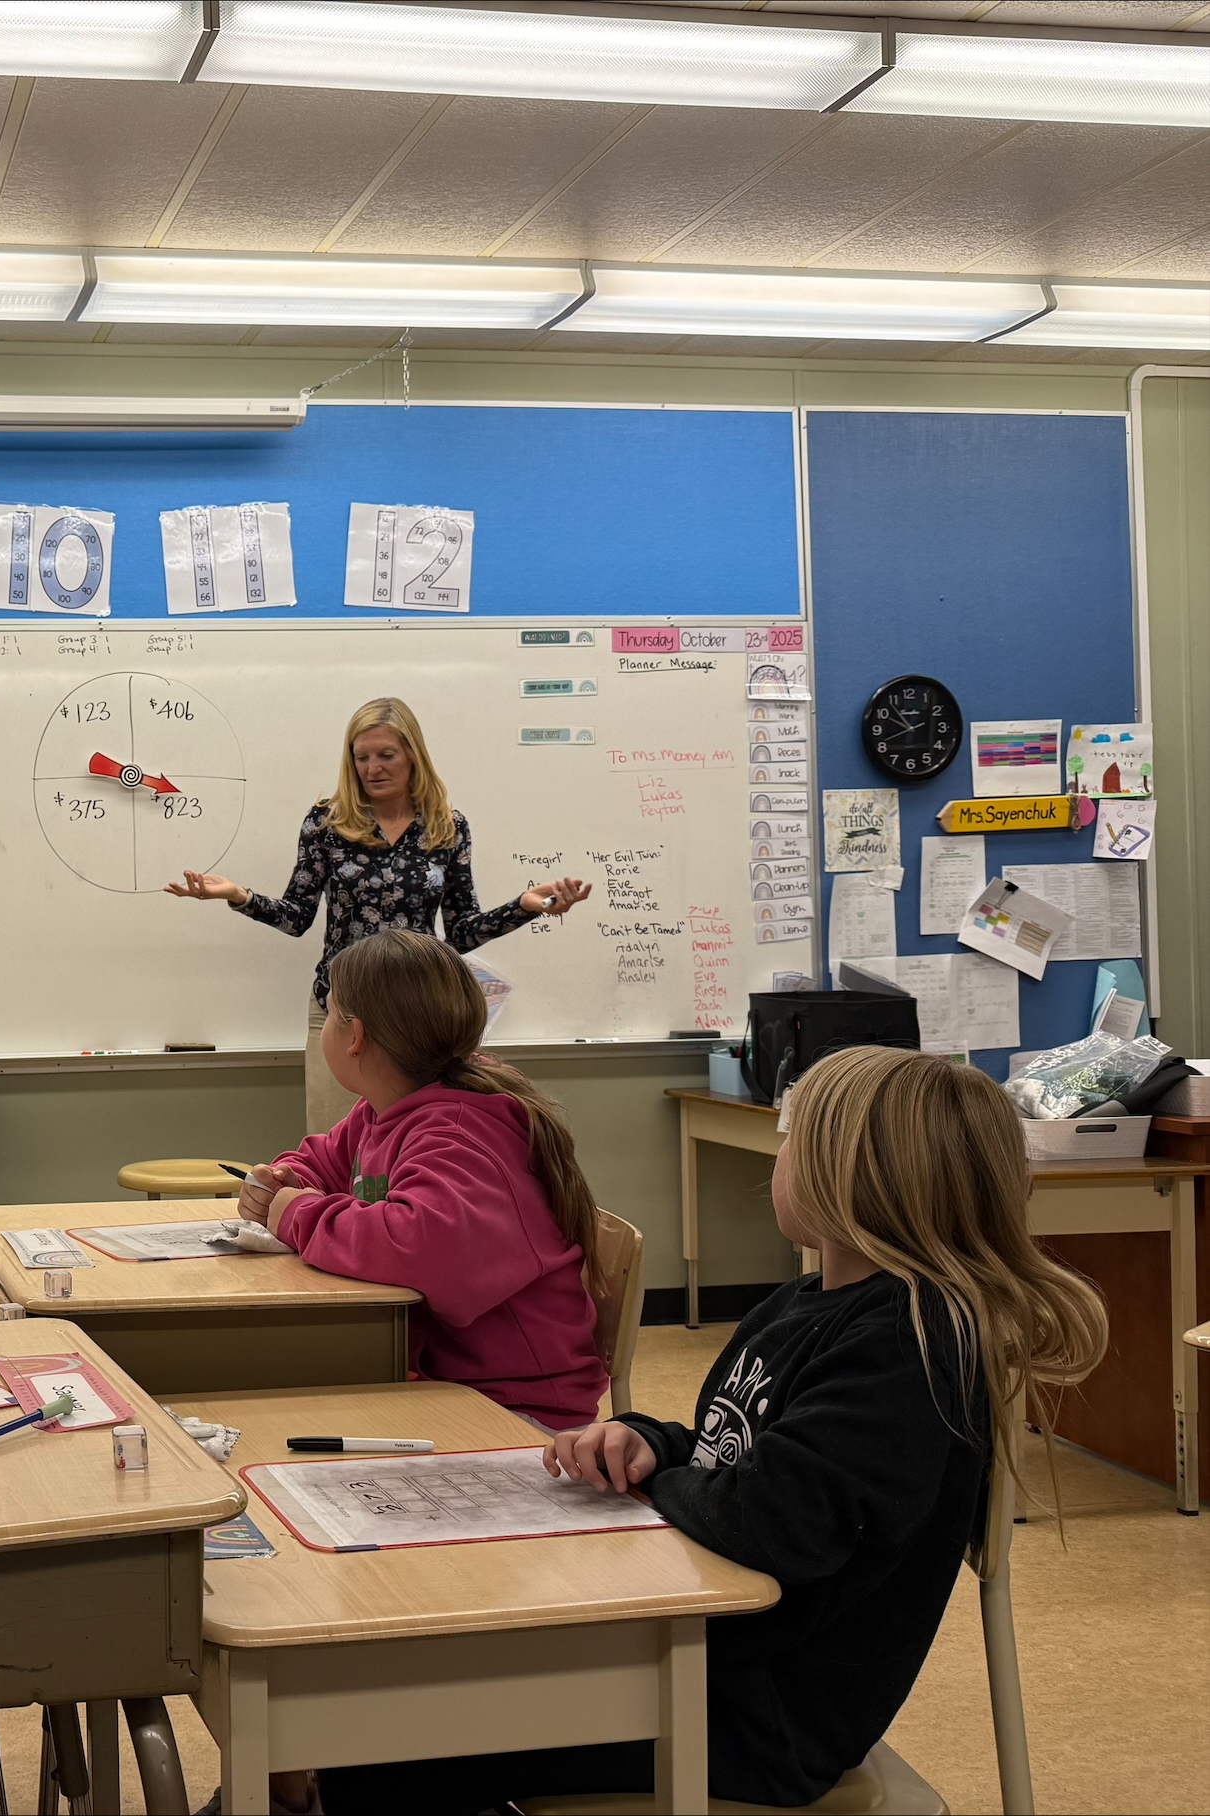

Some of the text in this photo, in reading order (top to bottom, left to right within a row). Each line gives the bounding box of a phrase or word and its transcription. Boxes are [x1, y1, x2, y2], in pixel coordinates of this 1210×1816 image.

[15, 534, 26, 542] 20
[86, 536, 96, 544] 70
[9, 511, 104, 609] 10
[189, 510, 266, 607] 11
[372, 510, 463, 608] 12
[379, 552, 389, 560] 36
[58, 595, 71, 603] 100
[200, 593, 211, 601] 66
[58, 635, 86, 646] Group
[148, 635, 174, 645] Group
[618, 631, 674, 650] Thursday
[681, 634, 727, 647] October
[746, 632, 768, 648] 23rd
[771, 630, 802, 647] 2025
[58, 646, 86, 656] Group
[146, 645, 172, 655] Group
[619, 657, 716, 673] Planner Message:
[903, 688, 915, 699] 12
[924, 693, 928, 703] 1
[889, 695, 898, 705] 11
[877, 708, 889, 719] 10
[932, 705, 942, 716] 2
[778, 726, 799, 736] Math
[872, 725, 882, 735] 9
[938, 722, 947, 733] 3
[878, 742, 887, 753] 8
[933, 740, 942, 750] 4
[778, 748, 801, 757] Recess
[922, 753, 931, 764] 5
[606, 751, 626, 764] To
[662, 750, 706, 768] Mooney
[890, 754, 899, 765] 7
[906, 759, 916, 770] 6
[778, 770, 800, 778] Snack
[637, 775, 666, 788] Liz
[641, 789, 682, 802] Lukas
[639, 803, 685, 821] Peyton
[960, 803, 1056, 826] Mrs. Sayenchuk
[841, 815, 884, 827] THINGS
[837, 839, 887, 855] Kindness
[615, 850, 633, 862] Evil
[605, 864, 640, 876] Rorie
[774, 864, 806, 874] Planners
[608, 879, 633, 889] Eve
[609, 899, 660, 911] Amarise
[531, 922, 551, 934] Eve
[634, 923, 649, 935] Be
[690, 919, 731, 935] Lukas
[616, 940, 660, 957] Adalyn
[618, 954, 664, 968] Amarise
[693, 954, 729, 968] Quinn
[617, 971, 657, 985] Kinsley
[694, 971, 717, 983] Eve
[694, 984, 727, 1000] Kinsley
[693, 998, 722, 1011] Zach
[694, 1013, 734, 1029] Adalyn
